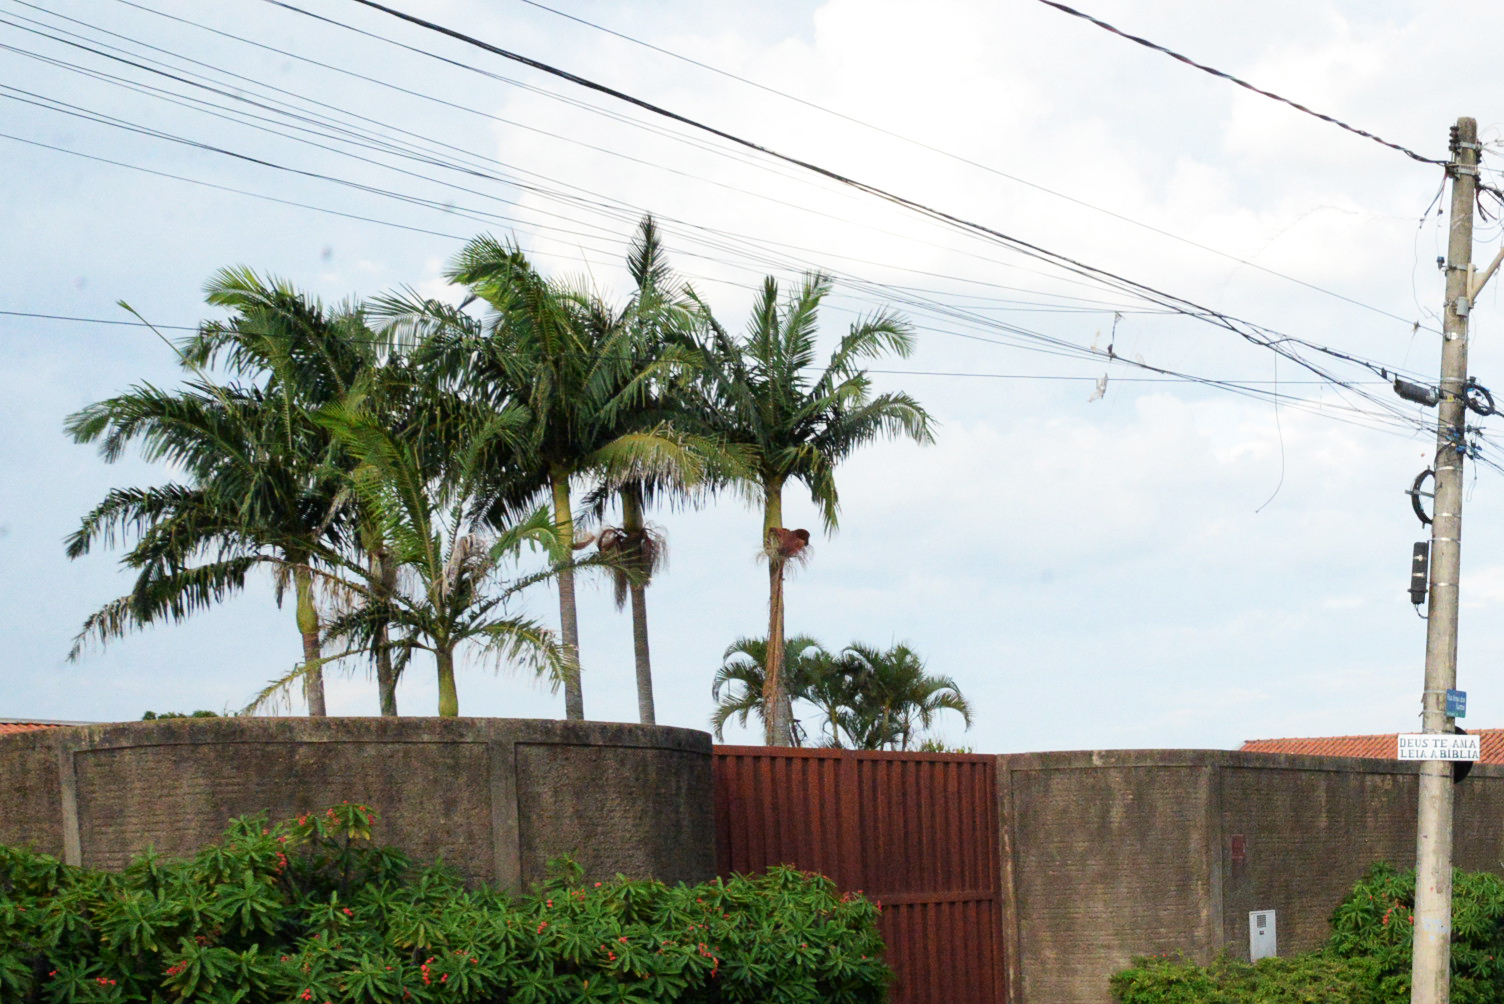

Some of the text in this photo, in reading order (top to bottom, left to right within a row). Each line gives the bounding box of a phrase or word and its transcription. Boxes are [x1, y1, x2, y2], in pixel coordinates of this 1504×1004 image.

[1400, 738, 1477, 749] DEUS TE AMA
[1400, 748, 1479, 759] LEIA A BÍBLIA
